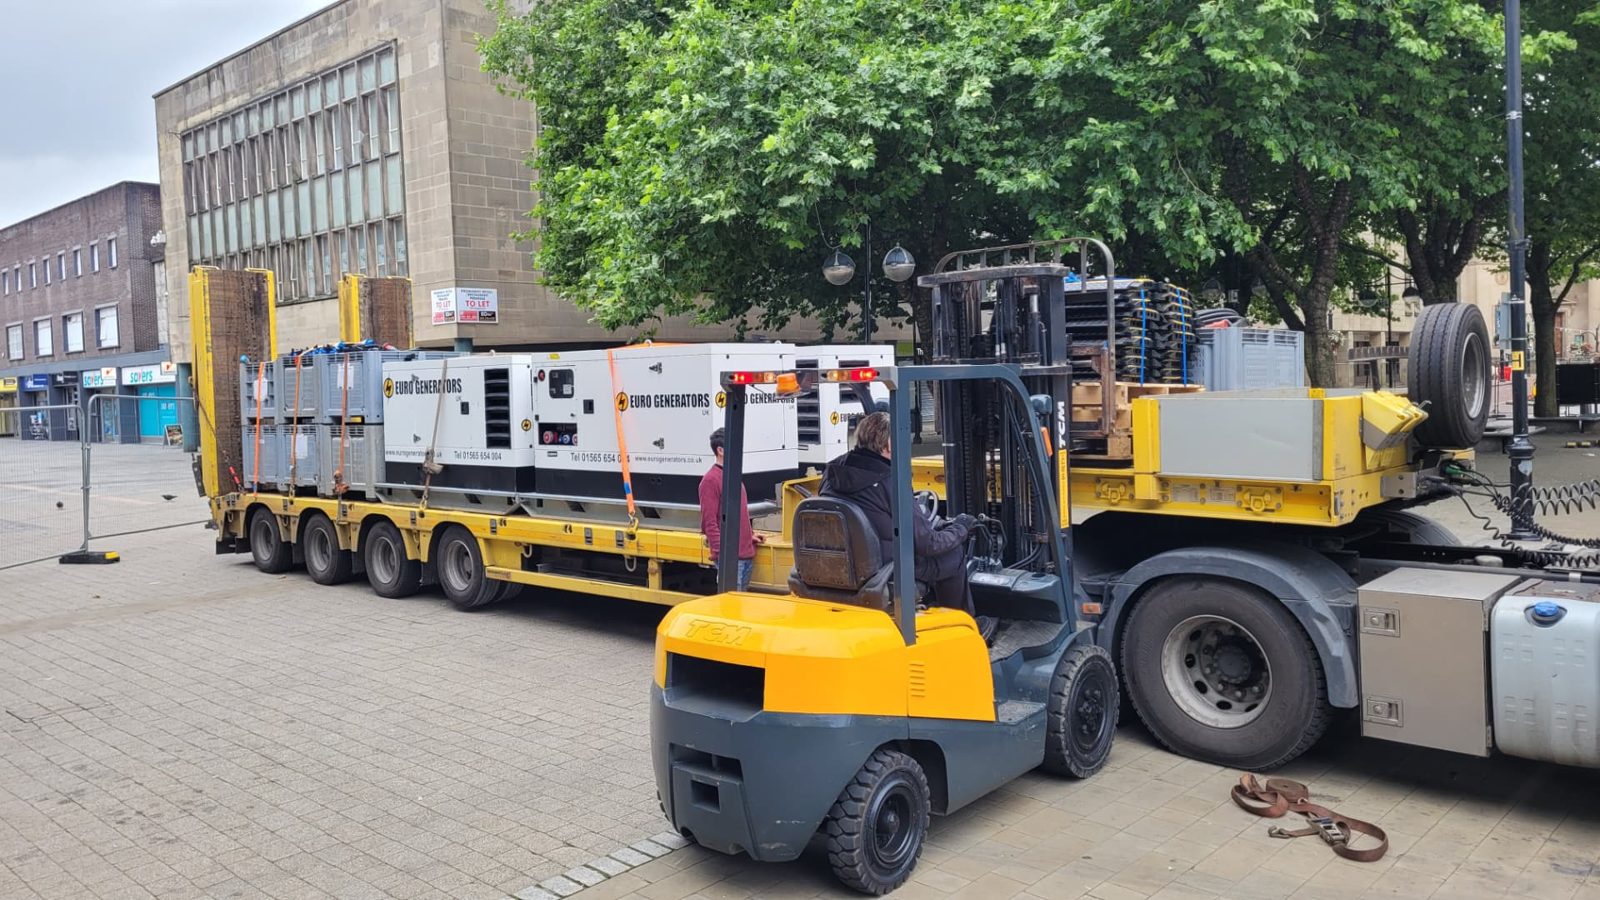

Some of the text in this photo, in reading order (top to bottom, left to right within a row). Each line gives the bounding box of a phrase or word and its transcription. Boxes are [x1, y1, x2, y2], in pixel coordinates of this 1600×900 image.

[395, 378, 462, 395] EURO GENERATORS
[630, 393, 710, 408] EURO GENERATORS
[1058, 401, 1066, 448] TCM
[463, 451, 479, 460] 01565
[570, 452, 580, 461] Tel
[581, 452, 602, 463] 01565
[603, 453, 616, 463] 654
[685, 619, 752, 646] TCM
